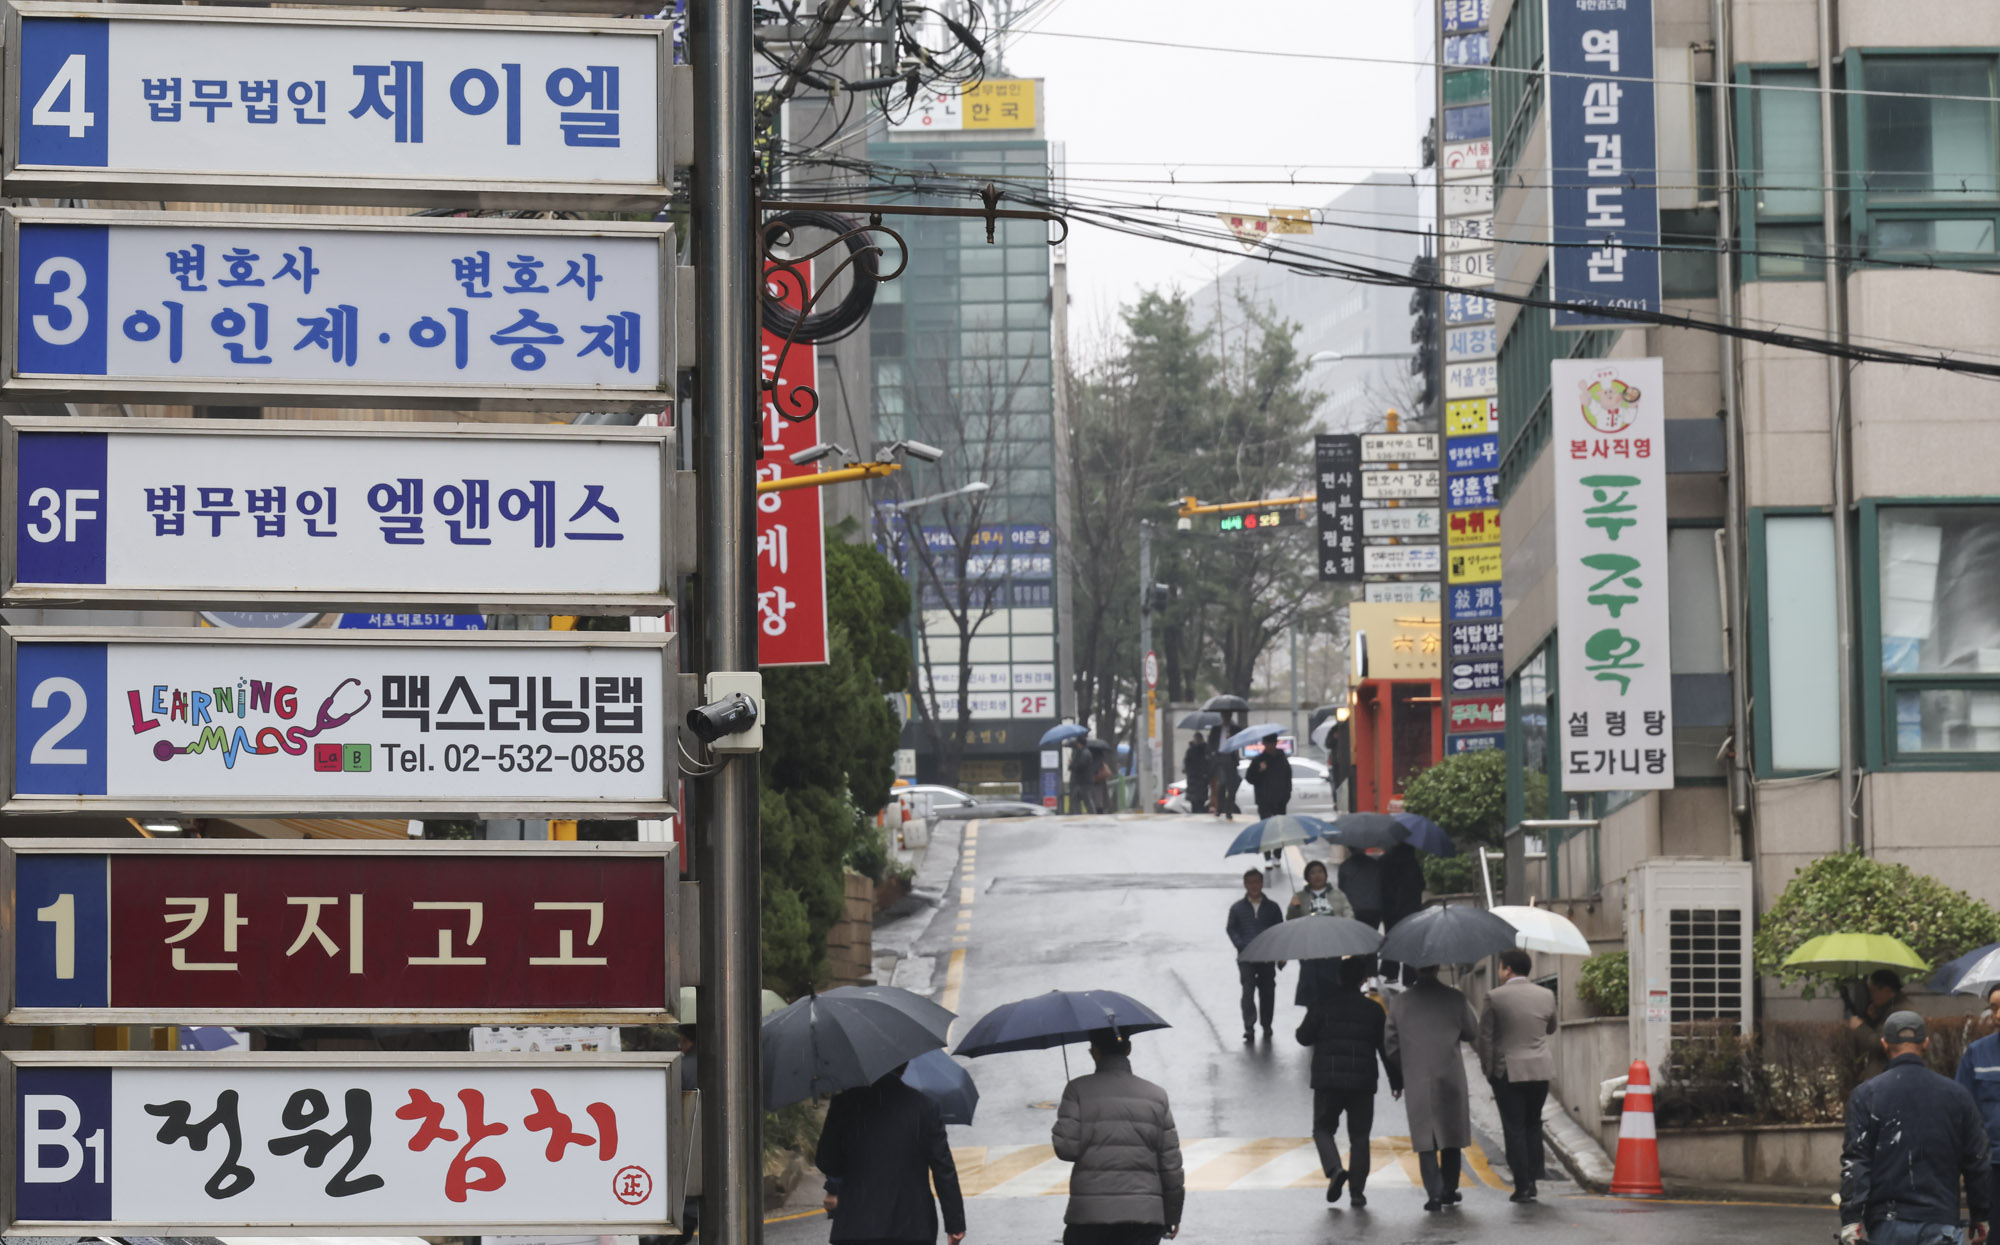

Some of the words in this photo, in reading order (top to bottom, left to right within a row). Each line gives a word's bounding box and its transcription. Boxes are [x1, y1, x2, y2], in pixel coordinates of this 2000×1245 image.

[32, 54, 94, 138] 4
[142, 78, 327, 126] 법무법인
[349, 60, 621, 148] 제이엘
[972, 102, 1018, 121] 한국
[1581, 29, 1628, 283] 역삼검도관
[32, 257, 89, 345] 3
[166, 244, 320, 294] 변호사
[451, 250, 603, 302] 변호사
[1570, 438, 1652, 459] 본사직영
[1367, 475, 1404, 487] 변호사
[26, 488, 99, 543] 3F
[143, 484, 338, 538] 법무법인
[367, 478, 625, 548] 엘앤에스
[1579, 475, 1645, 696] 푸주옥
[1453, 624, 1483, 643] 석탑
[29, 676, 88, 765] 2
[127, 679, 298, 735] LEARNING
[381, 675, 643, 734] 맥스러닝랩
[1021, 696, 1047, 714] 2F
[380, 743, 435, 773] Tel.
[443, 744, 646, 774] 02-532-0858
[1569, 748, 1667, 775] 도가니탕
[37, 893, 75, 980] 1
[163, 893, 608, 975] 칸지고고
[24, 1094, 105, 1184] B1
